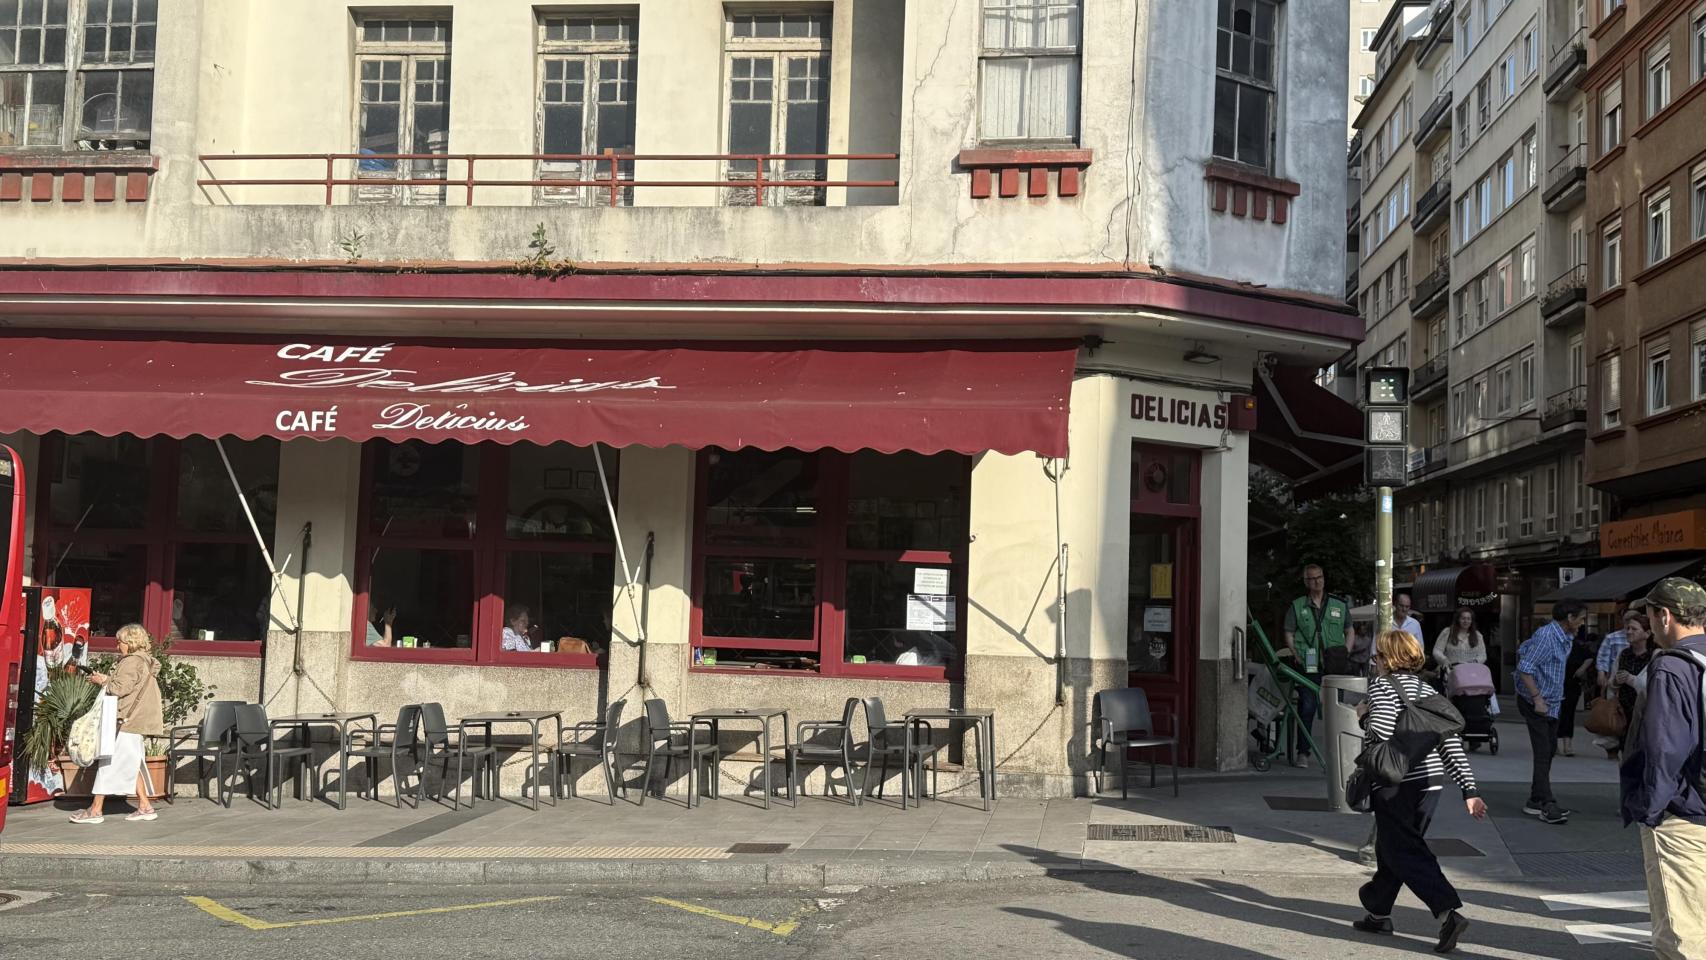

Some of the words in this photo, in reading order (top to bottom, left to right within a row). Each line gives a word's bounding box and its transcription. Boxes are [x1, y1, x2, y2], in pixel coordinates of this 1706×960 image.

[276, 343, 395, 363] CAFÉ
[275, 405, 338, 432] CAFÉ
[1130, 393, 1227, 430] DELICIAS
